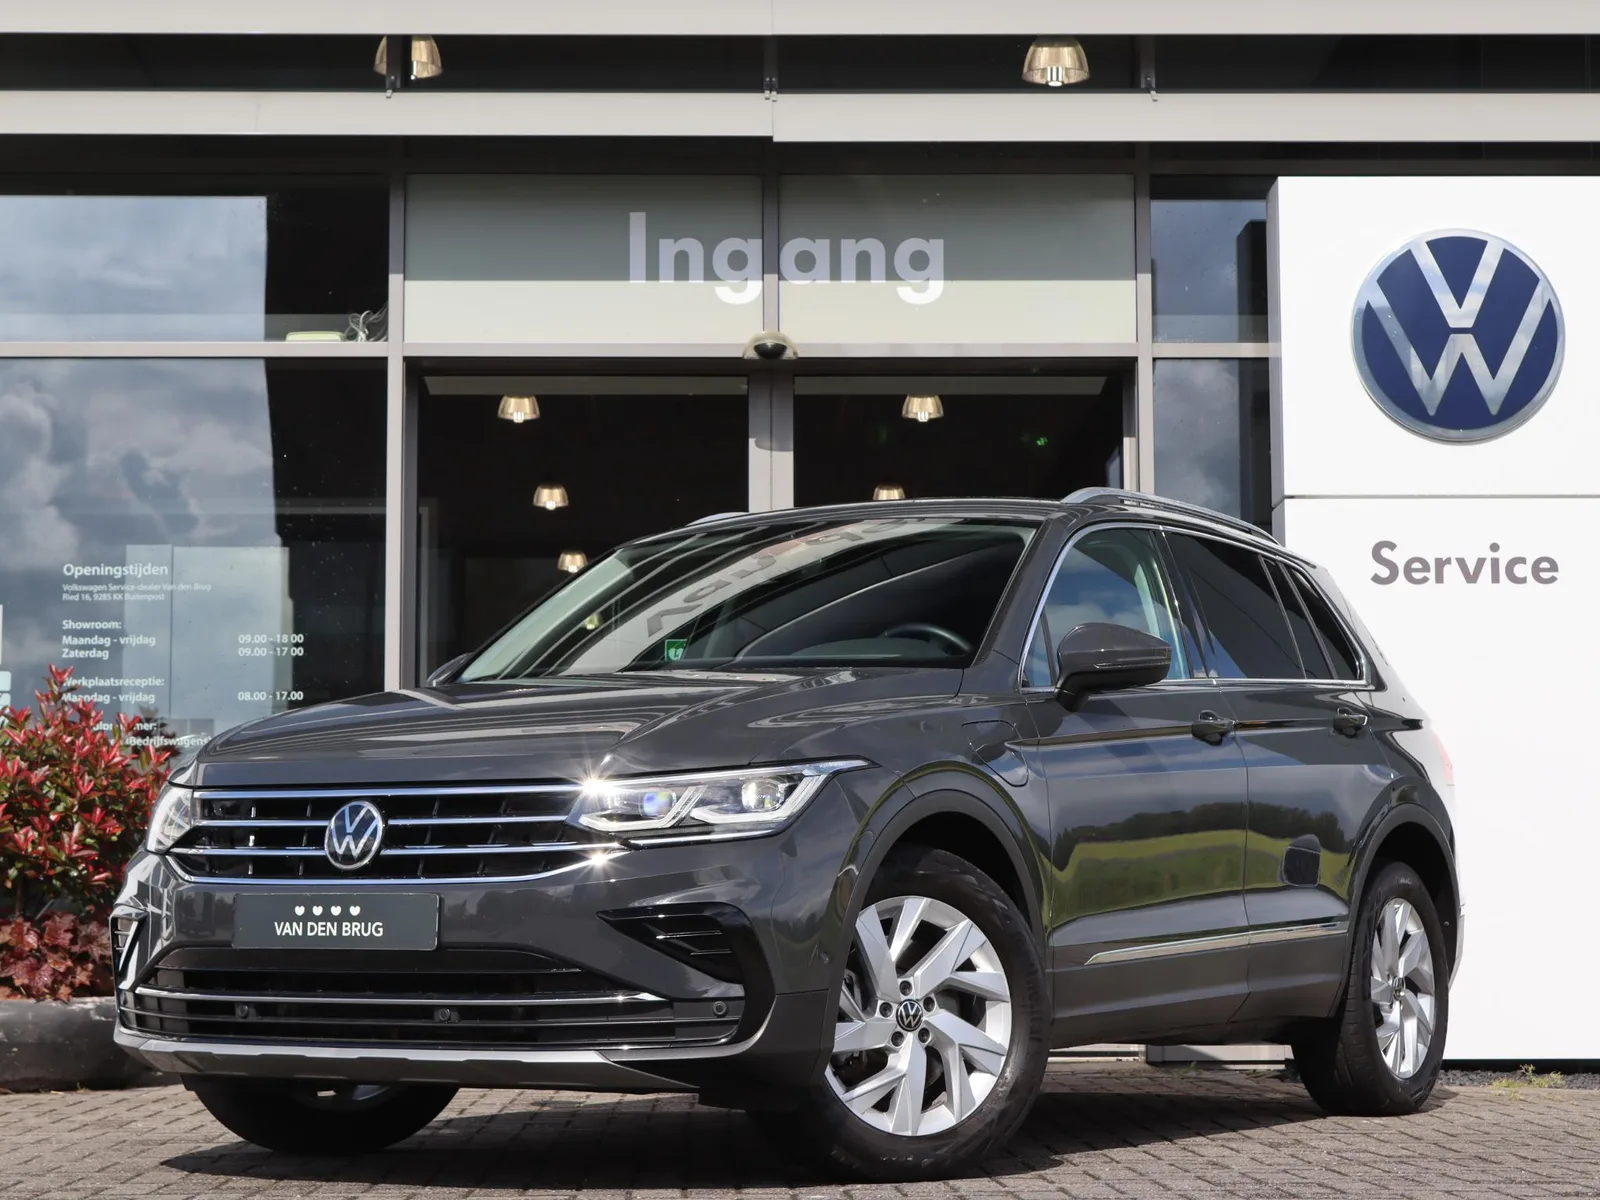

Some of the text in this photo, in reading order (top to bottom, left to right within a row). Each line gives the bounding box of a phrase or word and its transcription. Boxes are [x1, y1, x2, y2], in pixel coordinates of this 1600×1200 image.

[629, 212, 945, 305] Ingang
[1371, 540, 1560, 585] Service
[62, 563, 169, 579] Openingstijden
[61, 619, 122, 630] Showroom:
[61, 635, 111, 647] Maandag
[119, 634, 156, 647] vrijdag
[238, 633, 267, 644] 09.00
[61, 648, 109, 660] Zaterdag
[238, 646, 267, 657] 09.00
[118, 691, 155, 704] vrijdag
[237, 690, 267, 701] 08.00
[275, 690, 304, 701] 17.00
[274, 921, 384, 937] VAN DEN BRUG
